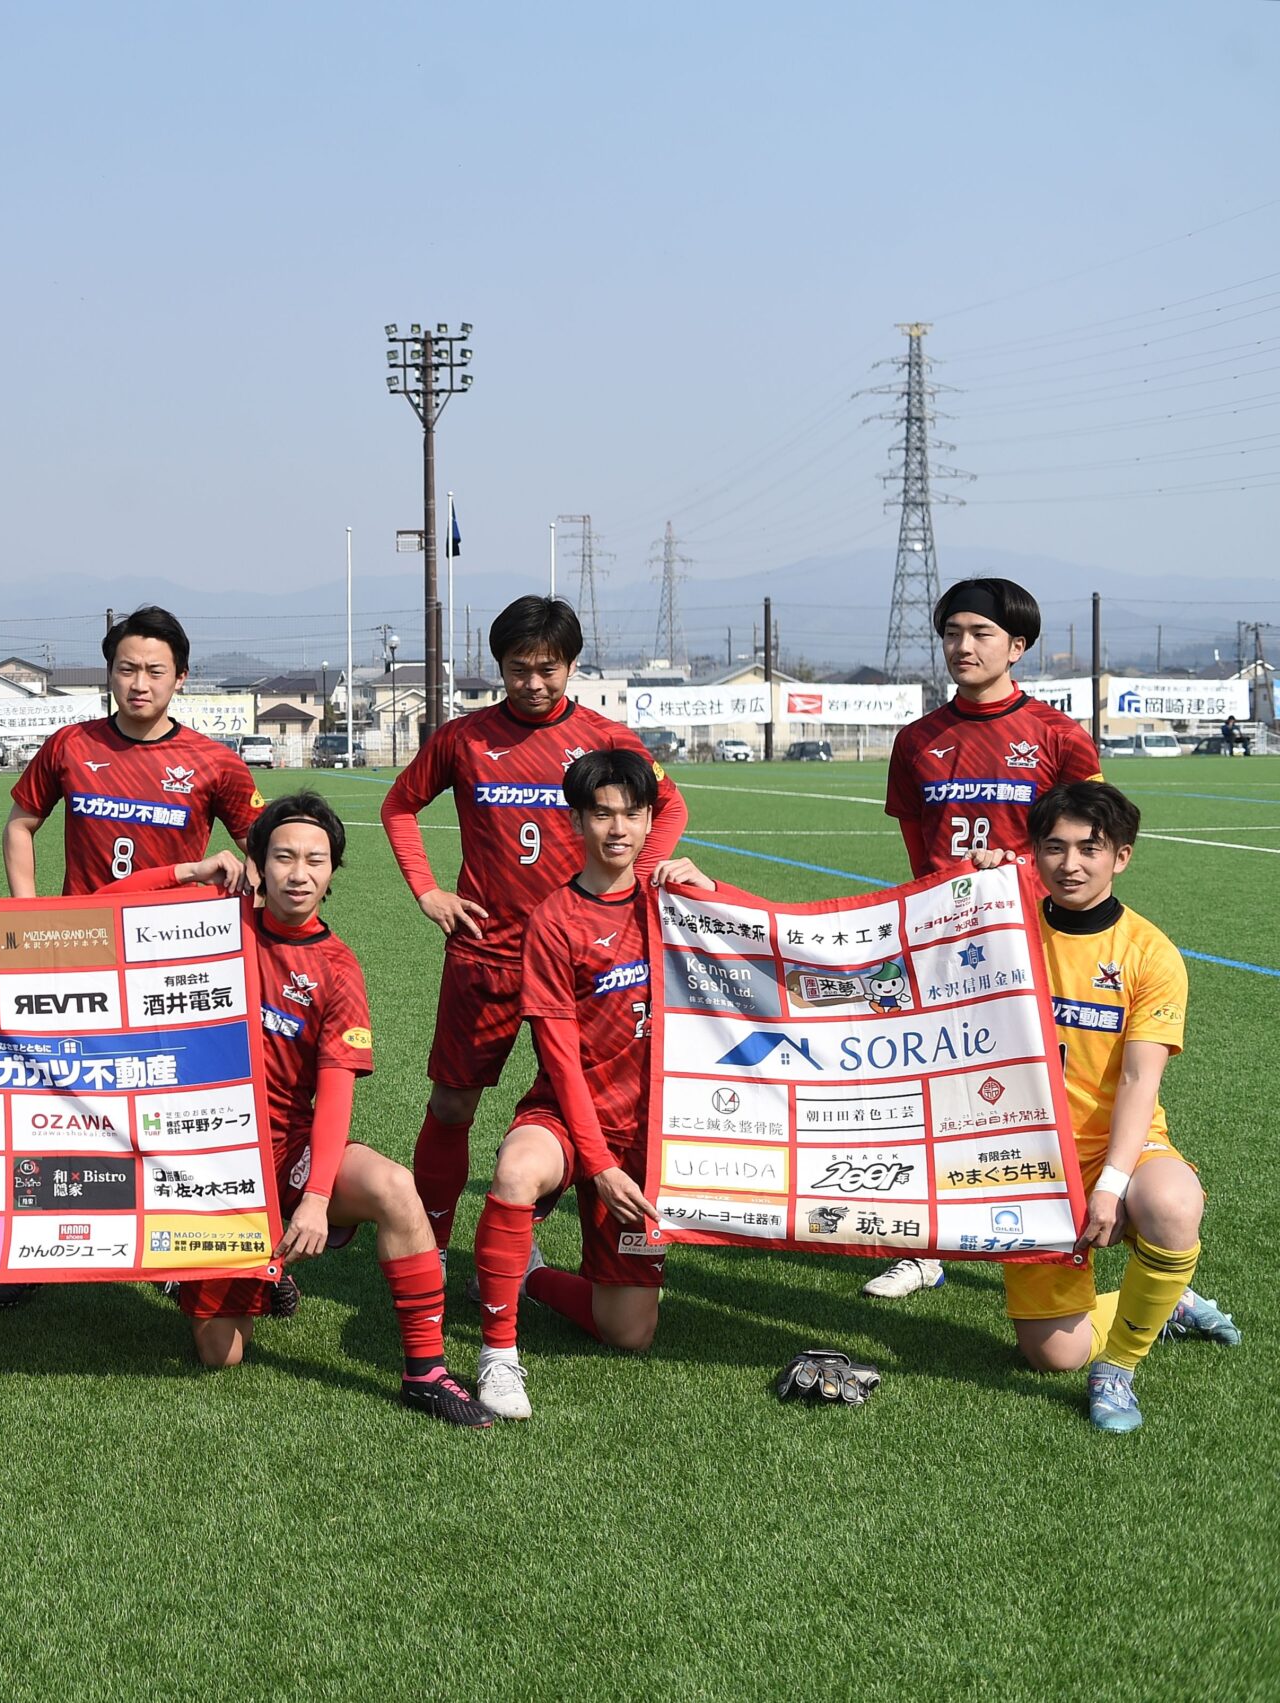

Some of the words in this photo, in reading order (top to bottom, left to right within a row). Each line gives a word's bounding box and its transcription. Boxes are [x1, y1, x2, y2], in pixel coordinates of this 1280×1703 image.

[660, 699, 724, 717] 株式会社
[1145, 697, 1226, 714] 岡崎建設
[924, 782, 1033, 803] スガカツ不動産
[73, 796, 187, 827] スガカツ不動産
[519, 822, 541, 865] 9
[951, 816, 990, 857] 28
[111, 837, 135, 880] 8
[914, 902, 993, 933] トヨタレンタリース
[995, 900, 1017, 910] 岩手
[954, 917, 979, 932] 水沢店
[23, 930, 61, 940] MIZUSAWA
[61, 930, 85, 940] GRAND
[86, 928, 109, 939] HOTEL
[136, 921, 233, 944] K-window
[787, 923, 893, 946] 佐々木工業
[23, 939, 109, 949] 水沢グランドホテル
[164, 972, 210, 987] 有限会社
[686, 957, 752, 981] Kennan
[687, 975, 730, 994] Sash
[733, 986, 755, 998] Ltd.
[927, 968, 1026, 1001] 水沢信用金庫
[143, 986, 233, 1016] 酒井電気
[840, 1022, 997, 1072] SORAie
[31, 1113, 116, 1131] OZAWA
[181, 1113, 252, 1134] 平野ターフ
[806, 1105, 915, 1122] 朝日田着色工芸
[939, 1108, 1050, 1133] 胆江日日新聞社
[668, 1116, 784, 1136] まこと鍼灸整骨院
[831, 1153, 899, 1161] SNACK
[977, 1148, 1022, 1164] 有限会社
[53, 1169, 68, 1184] 和
[83, 1170, 127, 1182] Bistro
[674, 1159, 776, 1179] UCHIDA
[947, 1161, 1056, 1186] やまぐち牛乳
[174, 1178, 256, 1199] 佐々木石材
[174, 1231, 234, 1240] MADOショップ
[238, 1231, 262, 1239] 水沢店
[855, 1216, 920, 1237] 琥珀
[19, 1242, 128, 1258] かんのシューズ
[189, 1240, 265, 1252] 伊藤硝子建材
